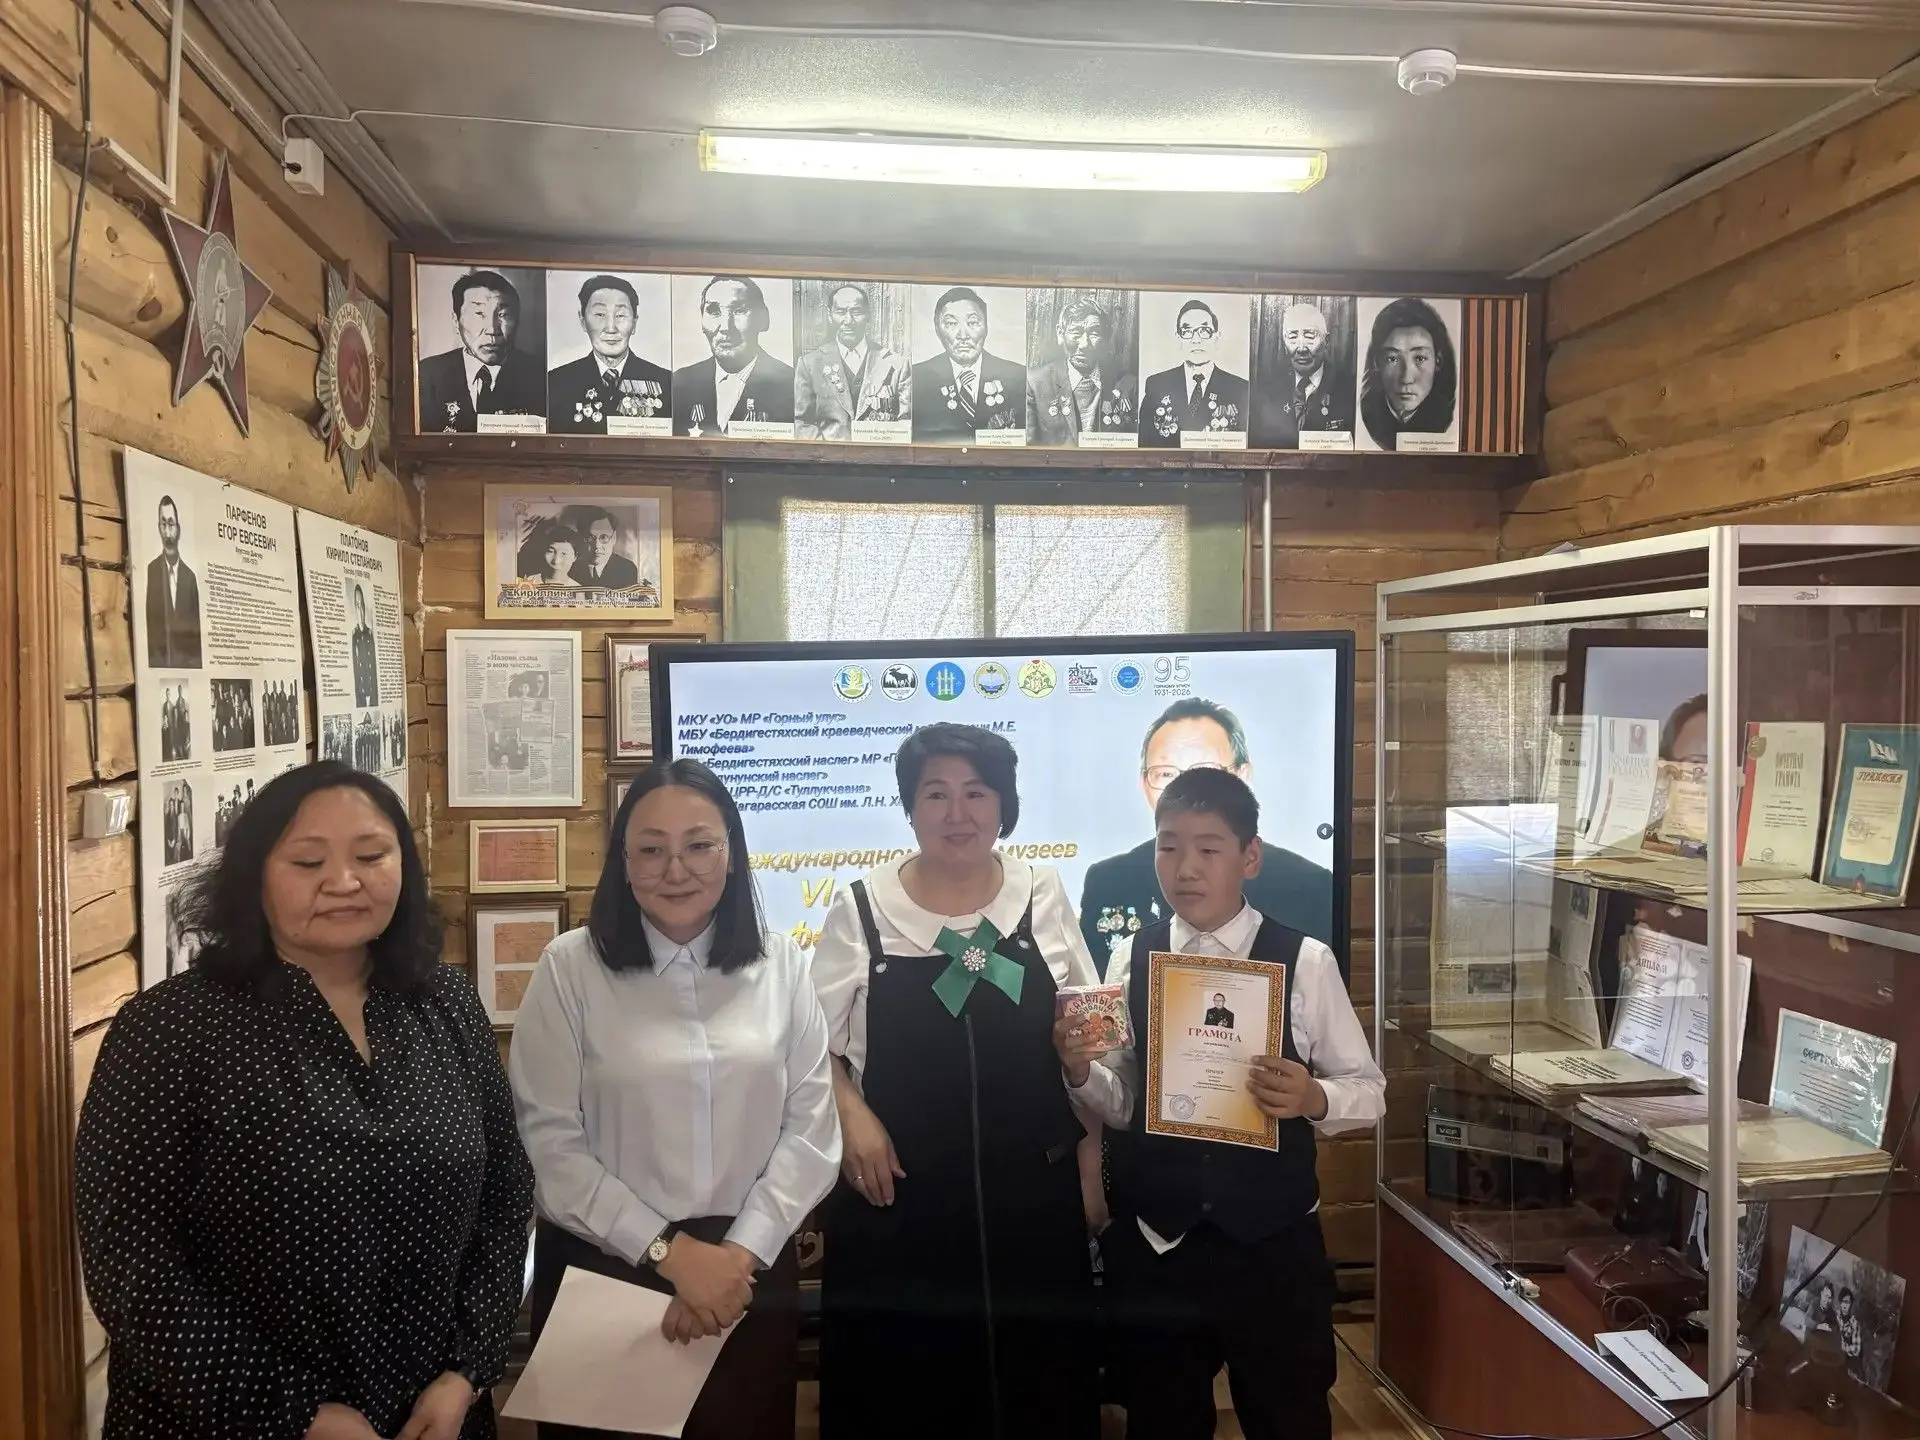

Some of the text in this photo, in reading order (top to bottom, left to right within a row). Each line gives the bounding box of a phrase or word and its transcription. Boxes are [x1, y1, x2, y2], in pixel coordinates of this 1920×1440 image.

[226, 503, 267, 529] ПАРФЕНОВ
[218, 522, 277, 552] ЕГОР ЕВСЕЕВИЧ
[340, 532, 369, 552] ПЛАТОНОВ
[326, 545, 383, 572] КИРИЛЛ СТЕПАНОВИЧ
[513, 588, 573, 598] Кириллина
[1154, 656, 1191, 683] 95
[1154, 688, 1191, 696] 1931-2026
[678, 714, 708, 726] МКУ
[709, 713, 739, 725] «УО»
[740, 713, 761, 724] МР
[763, 711, 814, 726] «Горный
[678, 729, 708, 740] МБУ
[709, 726, 819, 741] «Бердигестяхский
[821, 723, 913, 739] краеведческий
[680, 744, 756, 757] Тимофеева»
[812, 756, 860, 767] наслег»
[861, 753, 882, 764] МР
[781, 771, 829, 783] наслег»
[735, 800, 806, 813] агарасская
[808, 797, 839, 809] СОШ
[840, 799, 859, 808] им.
[748, 847, 912, 874] еждународно
[1188, 1027, 1242, 1043] ГРАМОТА
